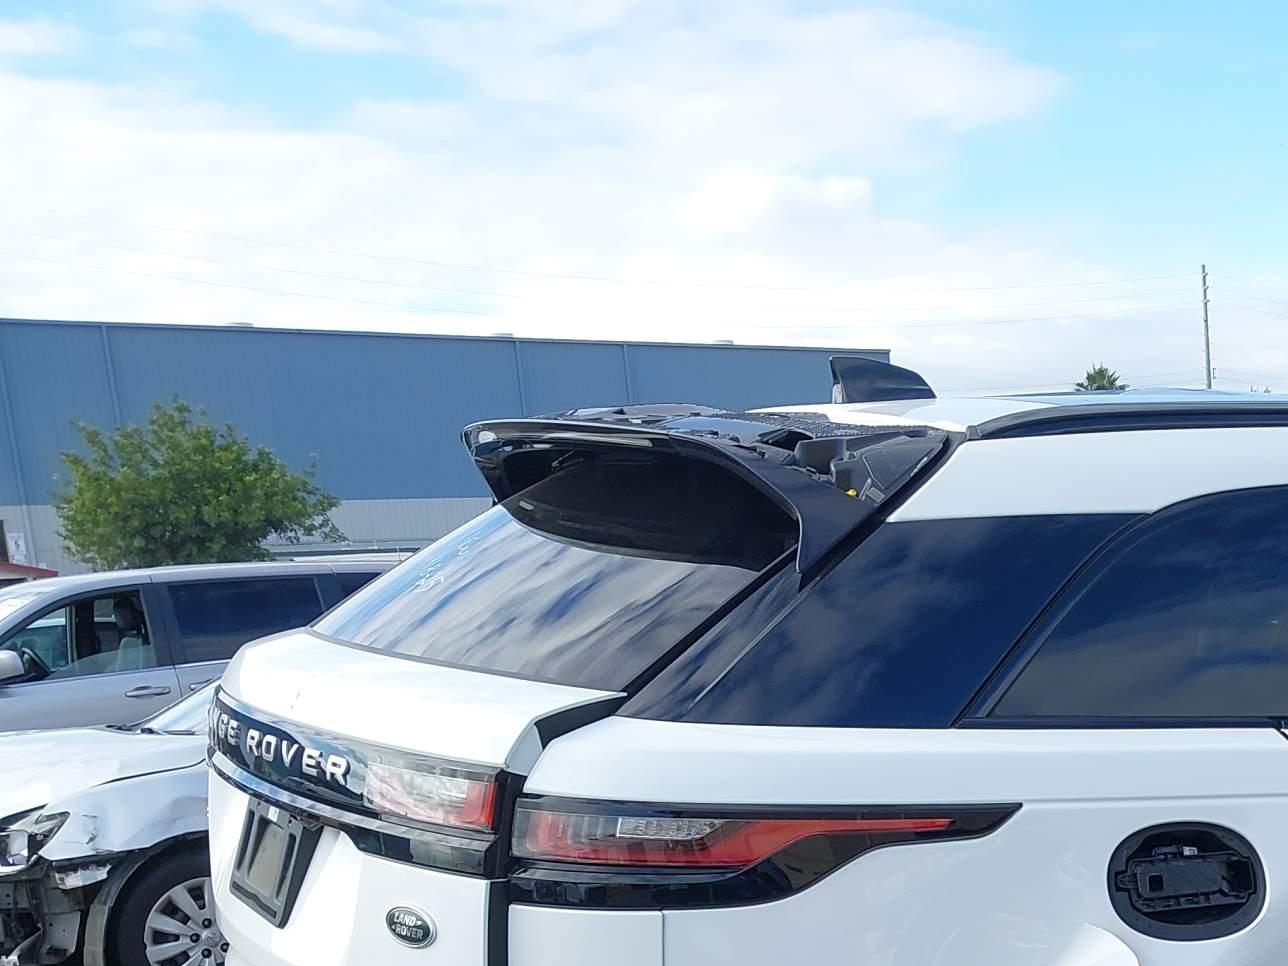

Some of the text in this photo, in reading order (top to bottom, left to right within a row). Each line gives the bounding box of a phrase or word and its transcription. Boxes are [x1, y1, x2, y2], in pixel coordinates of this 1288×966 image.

[246, 728, 349, 786] ROVER
[393, 911, 417, 927] LAND
[395, 923, 424, 940] ROVER
